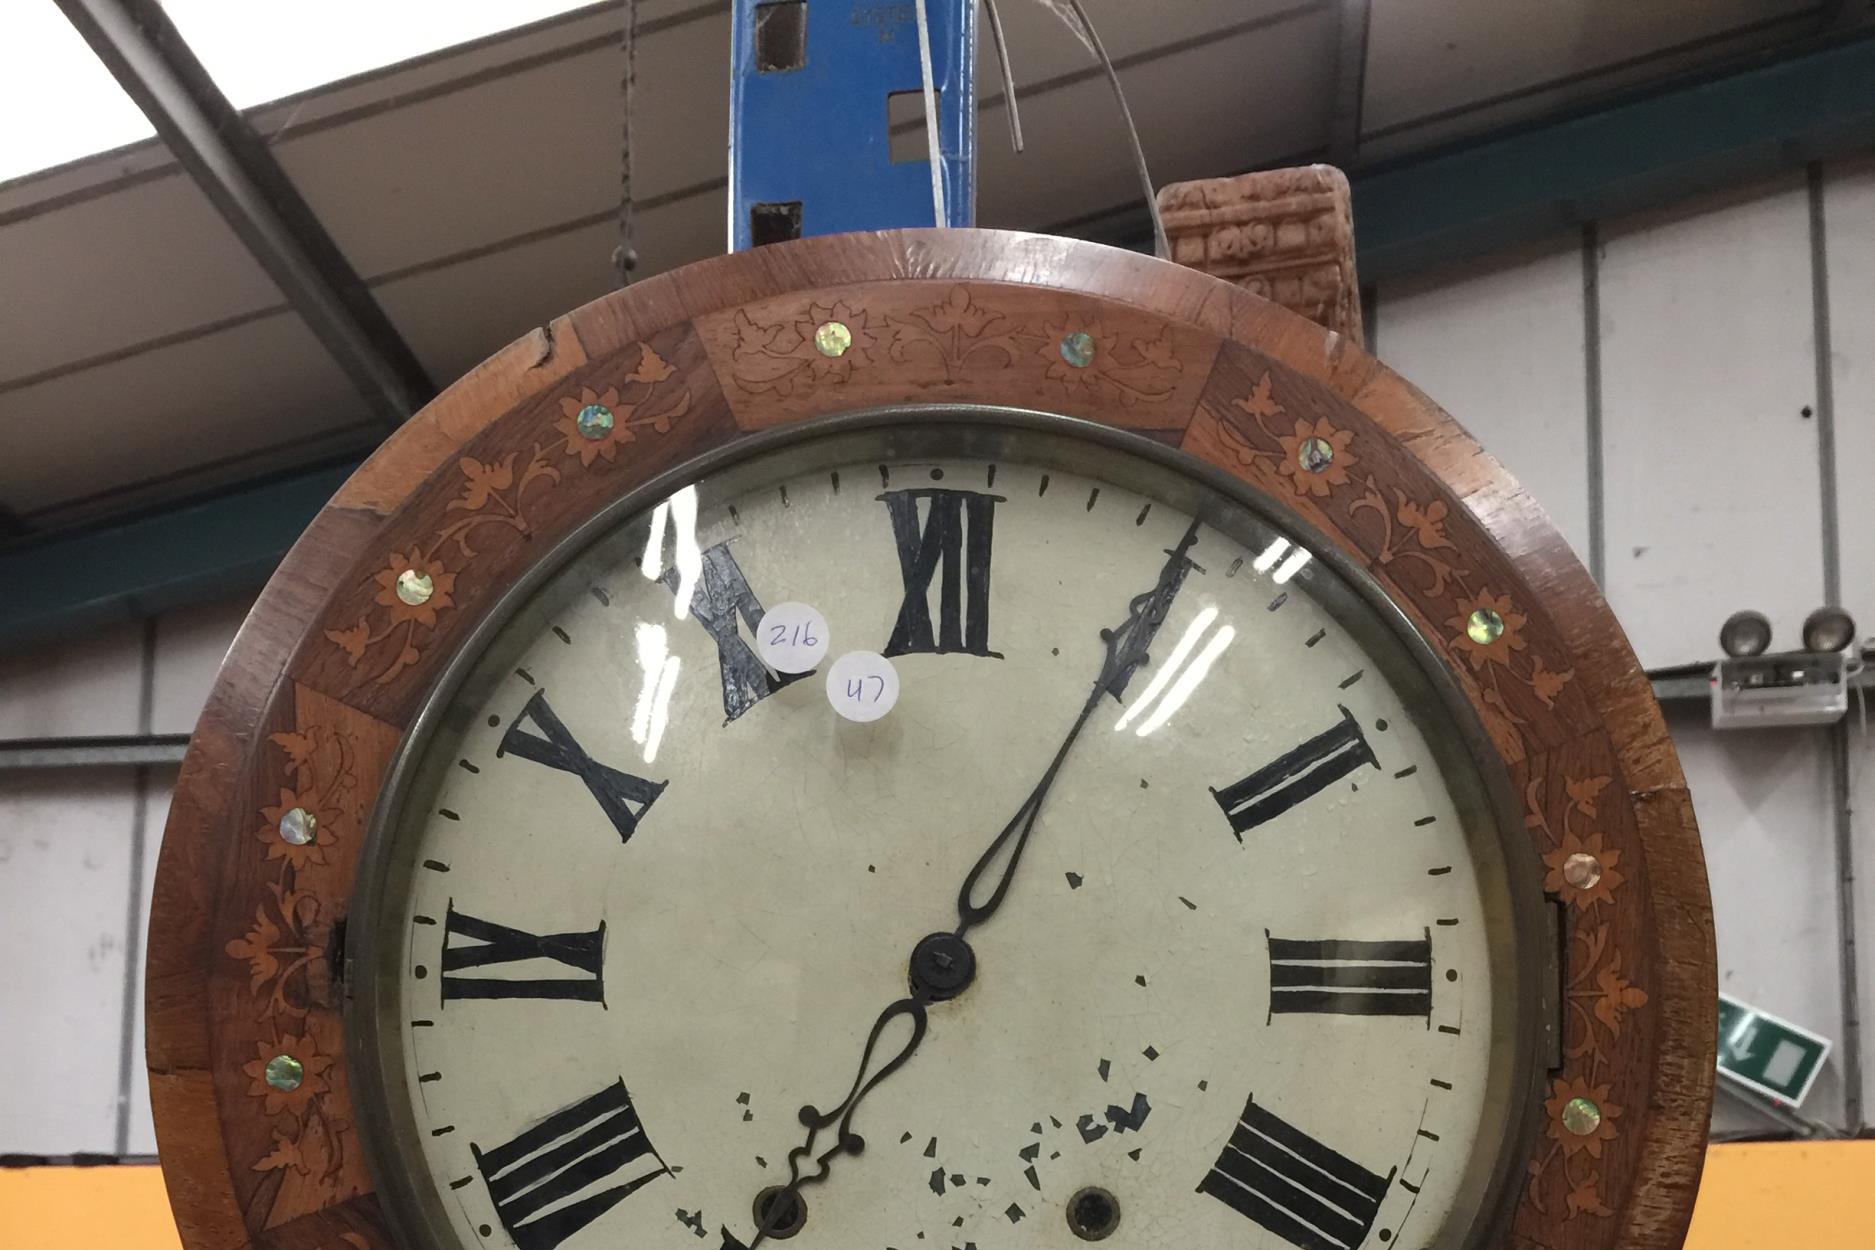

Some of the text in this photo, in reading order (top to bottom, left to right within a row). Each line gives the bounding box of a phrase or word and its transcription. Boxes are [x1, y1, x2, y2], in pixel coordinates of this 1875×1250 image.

[876, 488, 1006, 660] XII
[769, 620, 819, 648] 216
[847, 674, 885, 703] 47
[496, 688, 670, 844] X
[1209, 703, 1382, 844] II
[440, 897, 608, 1010] IX
[1265, 927, 1433, 1030] III
